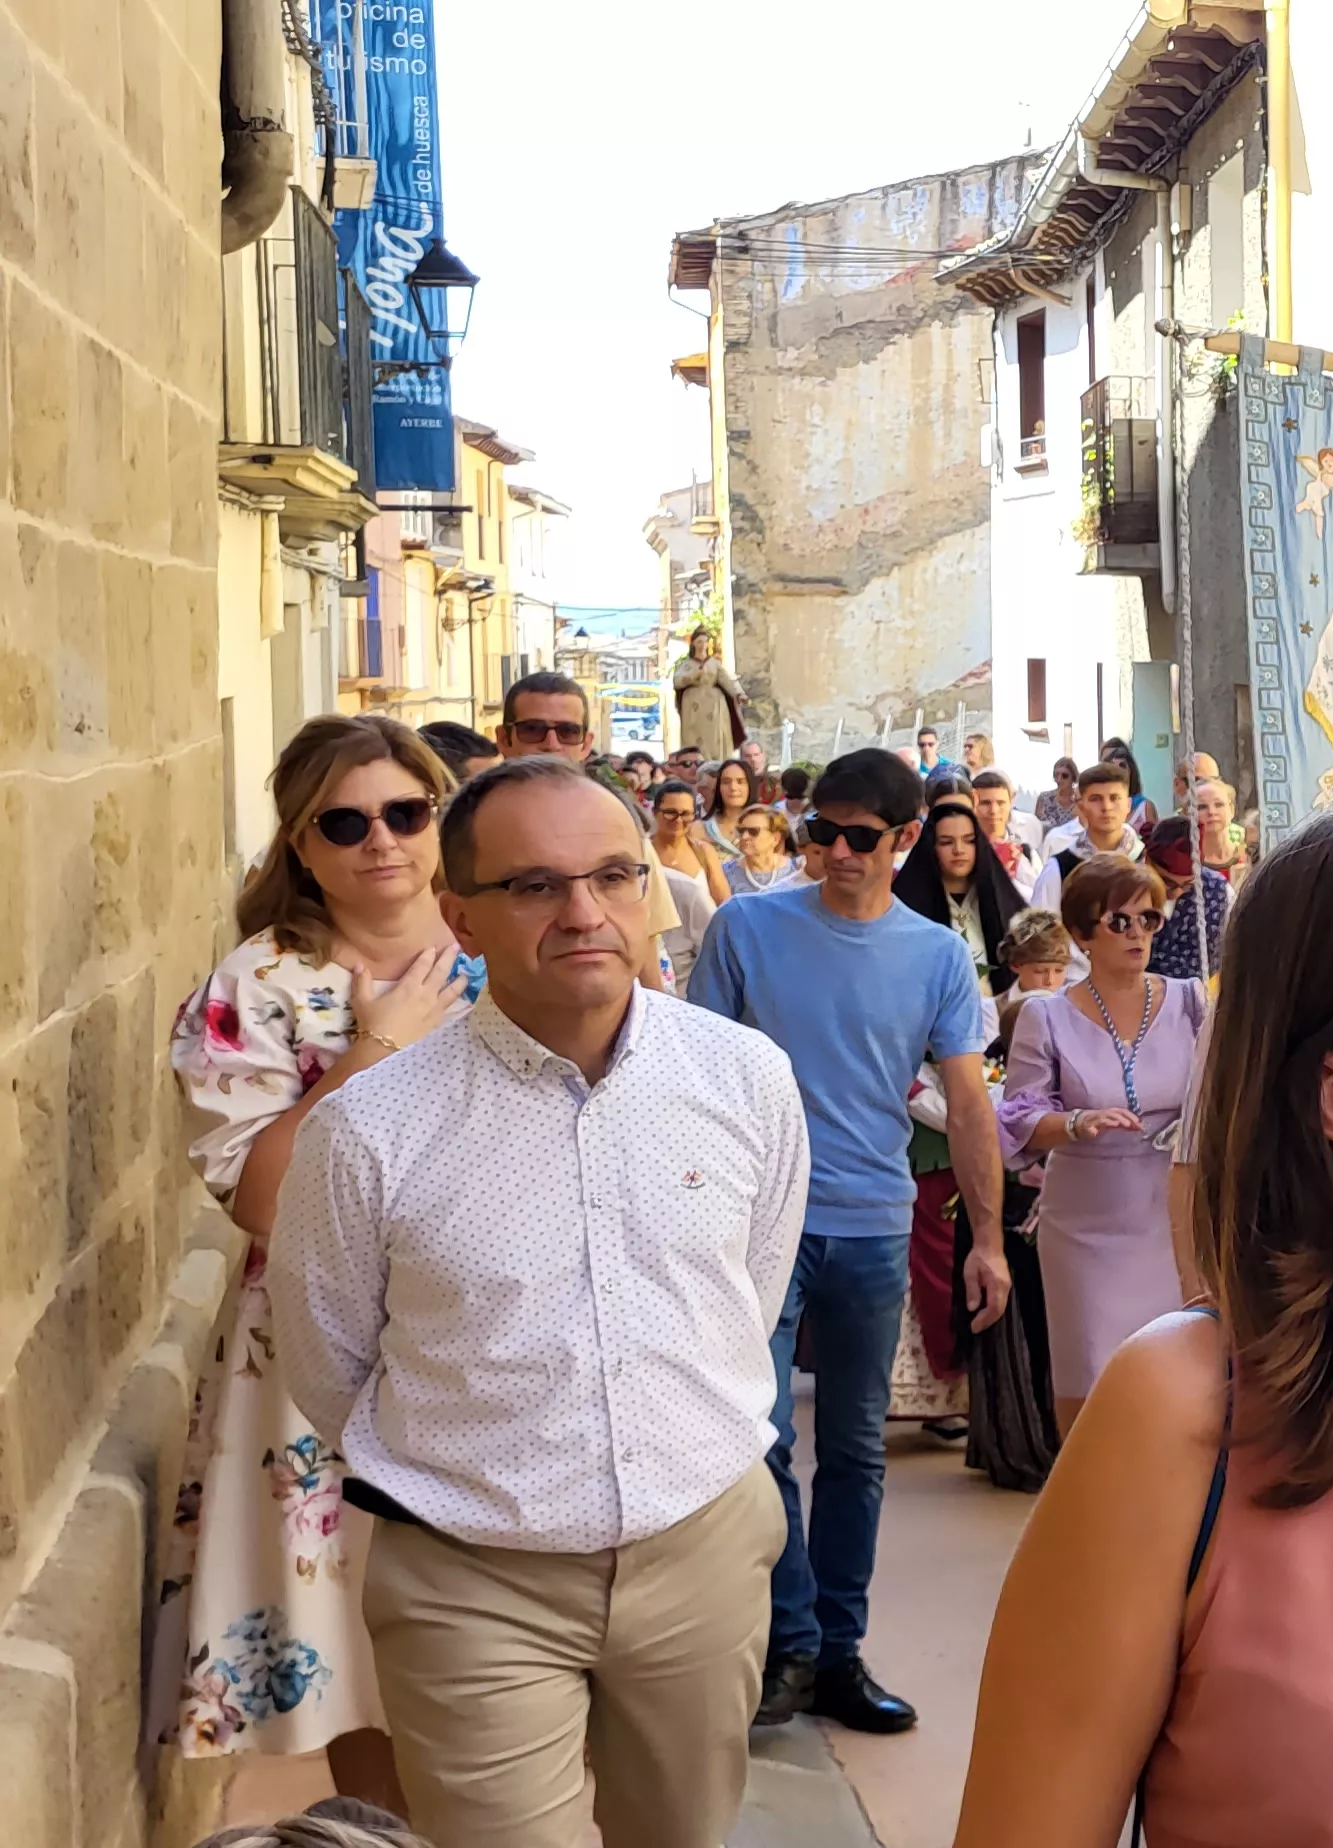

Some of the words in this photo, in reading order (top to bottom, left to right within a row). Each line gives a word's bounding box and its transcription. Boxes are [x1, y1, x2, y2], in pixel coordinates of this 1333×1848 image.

[338, 0, 425, 24] oicina
[392, 28, 426, 50] de
[326, 50, 427, 76] tuismo
[411, 96, 431, 164] huesca
[411, 169, 432, 193] de
